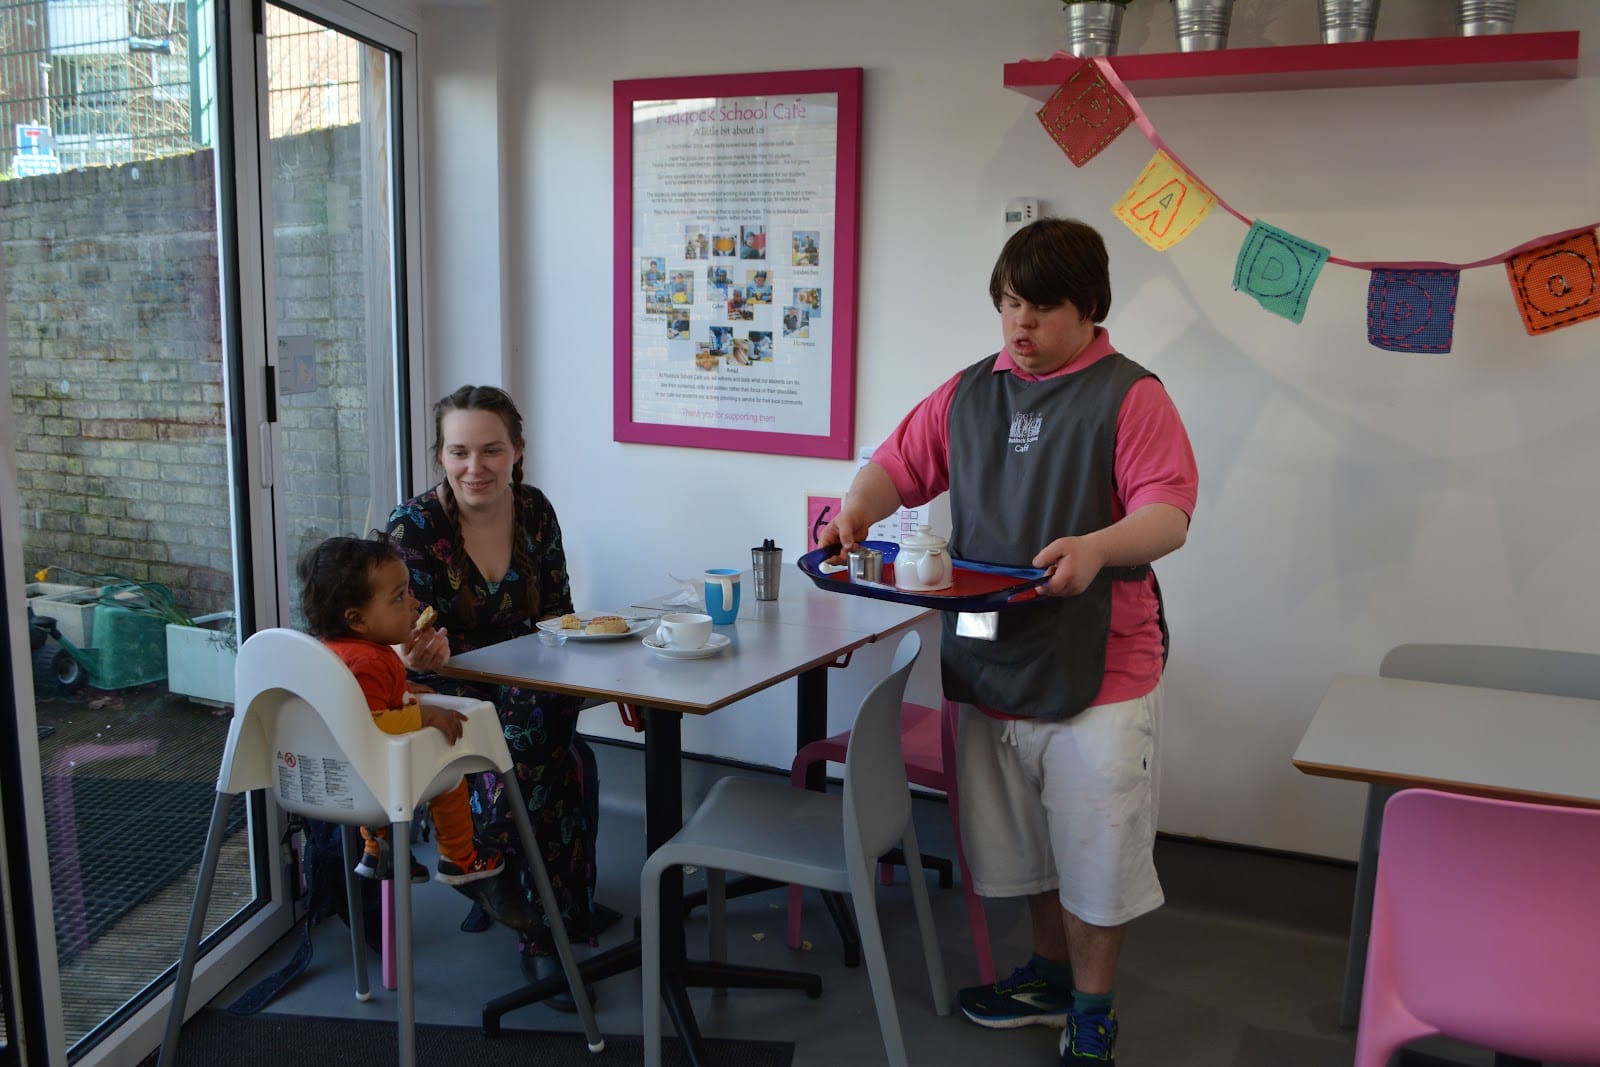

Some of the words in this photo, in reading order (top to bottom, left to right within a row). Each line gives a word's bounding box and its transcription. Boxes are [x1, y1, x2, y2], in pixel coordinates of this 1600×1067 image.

[719, 101, 768, 121] School
[772, 98, 807, 120] Café
[720, 126, 730, 136] bit
[732, 125, 755, 135] about
[1055, 82, 1111, 132] P
[1130, 178, 1188, 239] A
[1246, 234, 1302, 299] D
[1380, 275, 1433, 341] D
[725, 413, 758, 423] supporting
